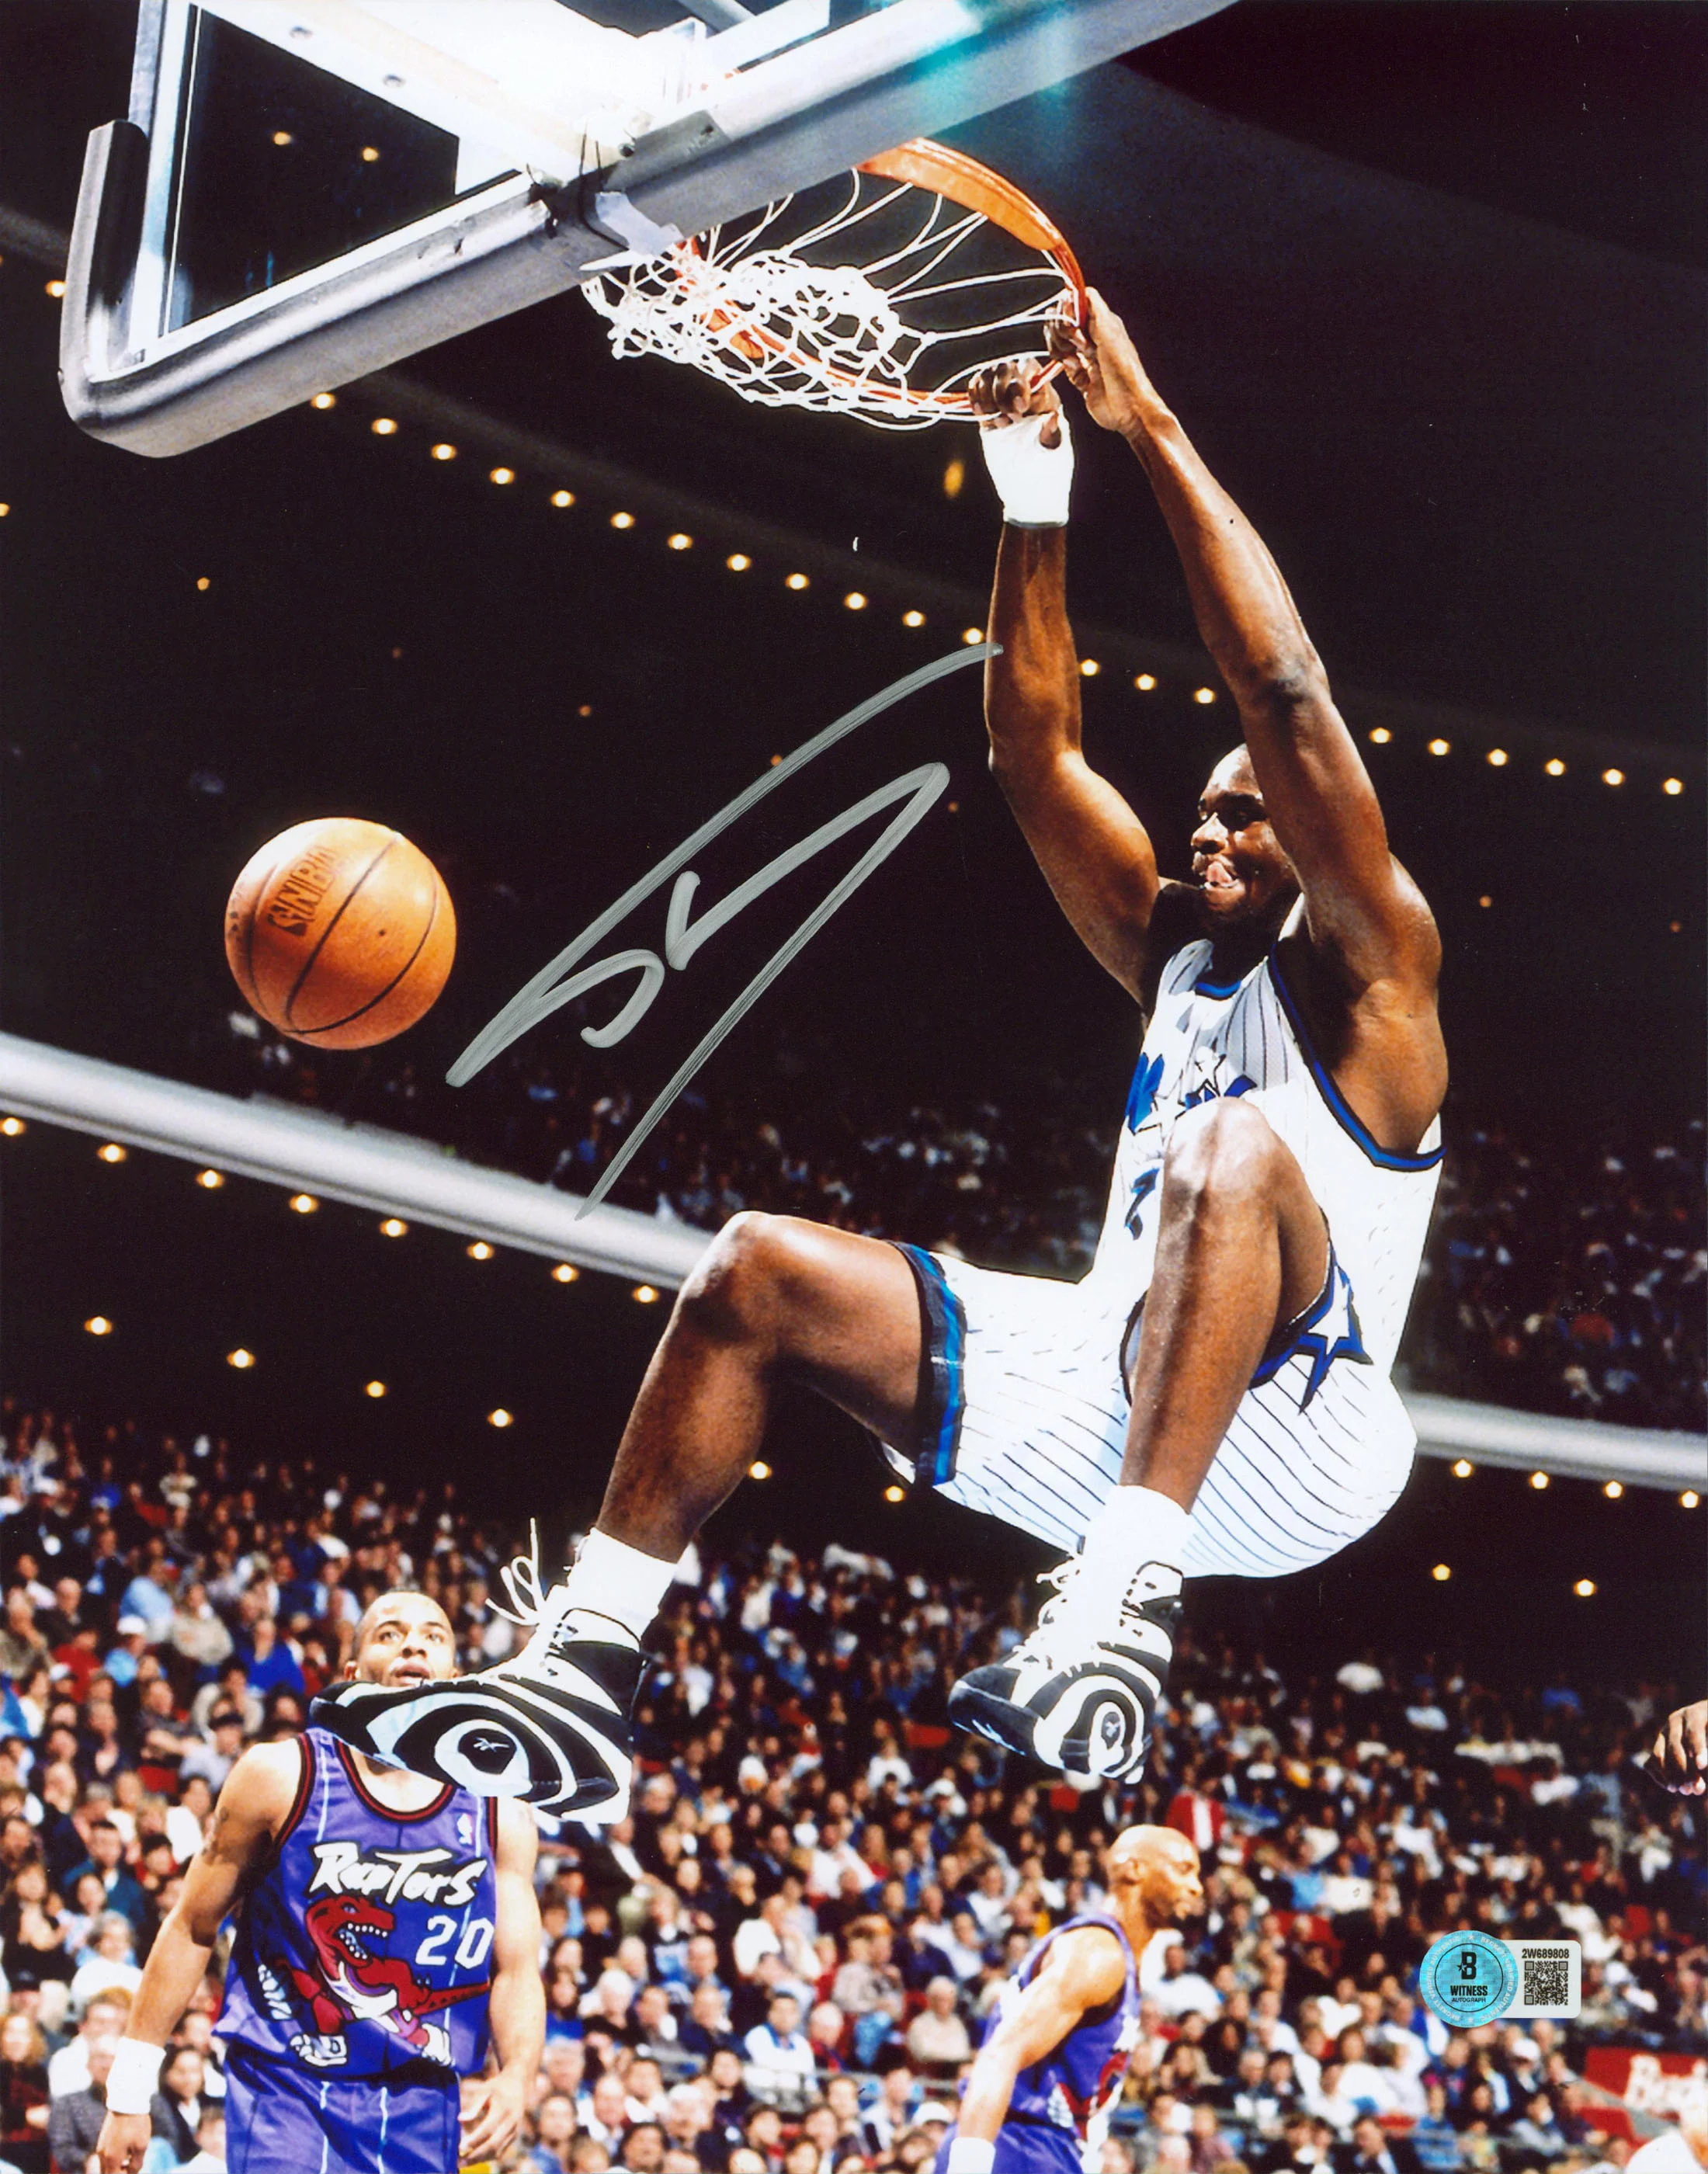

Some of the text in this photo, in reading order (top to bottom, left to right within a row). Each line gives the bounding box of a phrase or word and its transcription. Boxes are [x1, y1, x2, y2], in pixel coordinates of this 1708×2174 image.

[415, 1915, 494, 1969] 20
[1522, 1948, 1569, 1959] 2W689808
[1450, 1985, 1488, 1996] WITNESS
